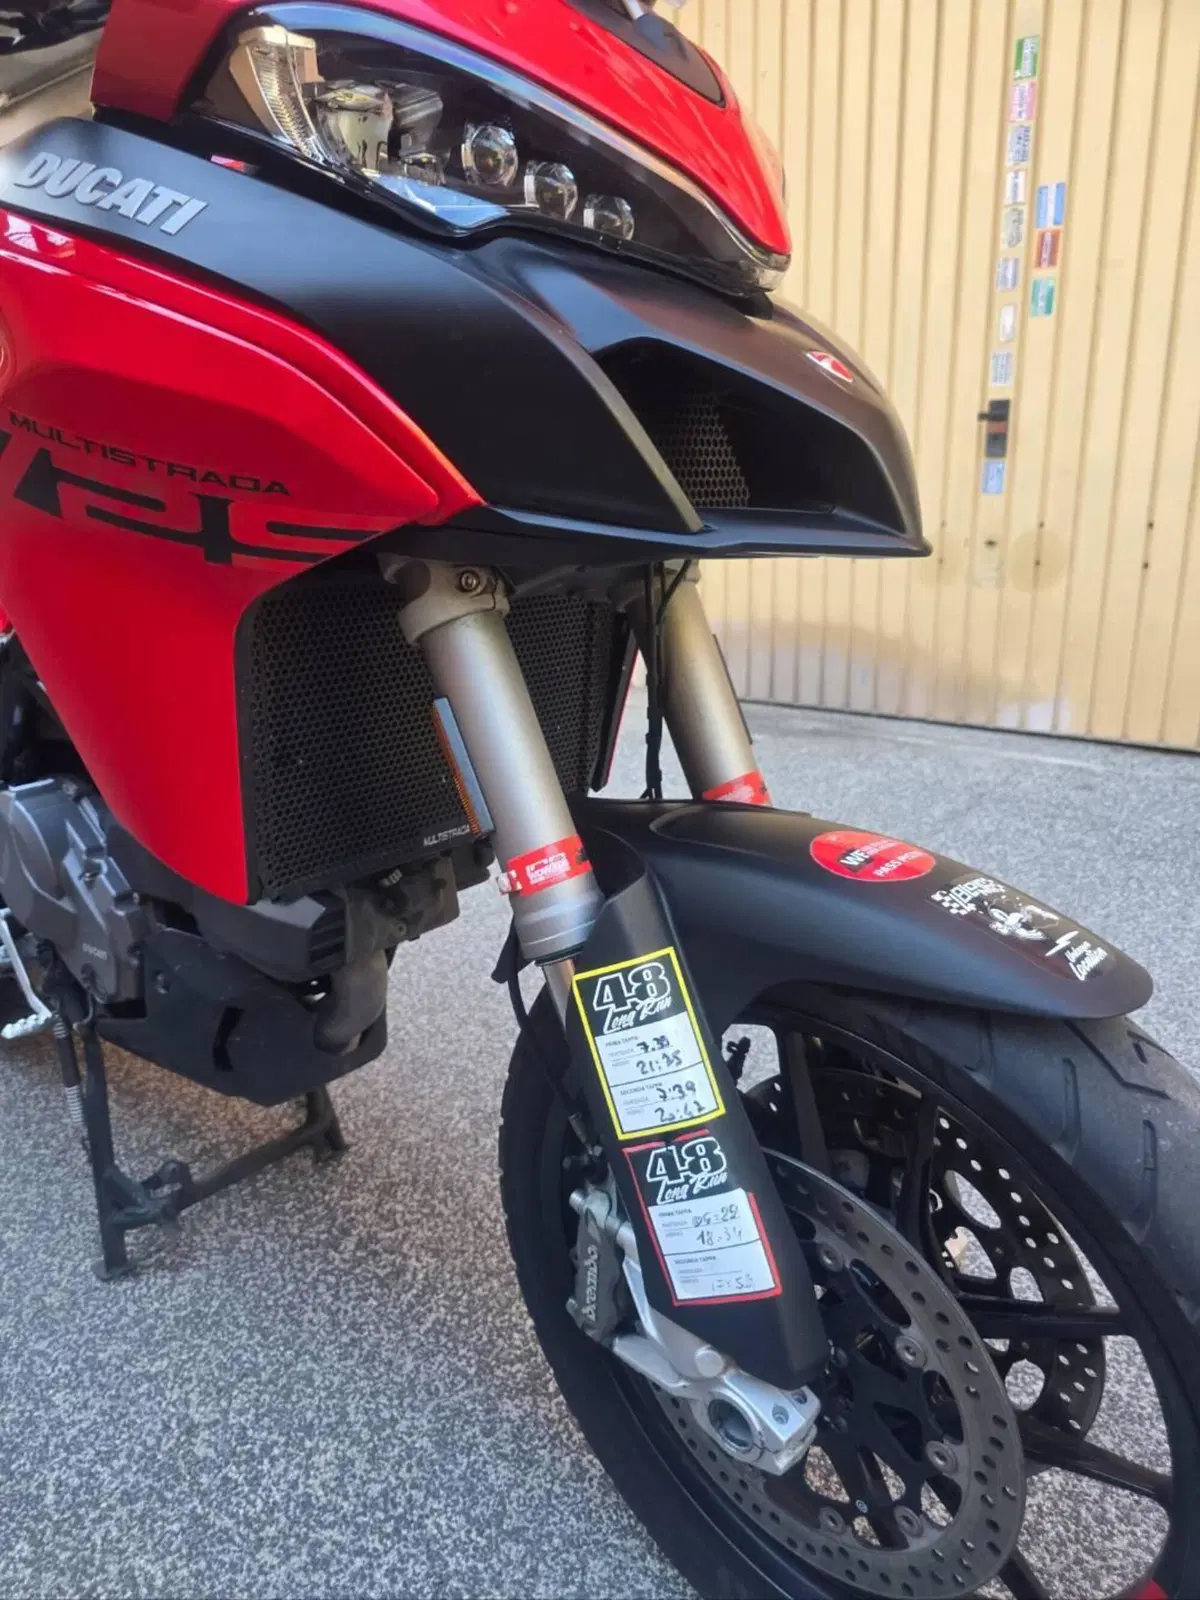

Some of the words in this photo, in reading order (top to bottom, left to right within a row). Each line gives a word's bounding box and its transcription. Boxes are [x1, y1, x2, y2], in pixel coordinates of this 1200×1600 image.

[13, 151, 208, 236] DUCATI
[8, 411, 291, 496] MULTISTRADA
[593, 961, 672, 1013] 48
[602, 1006, 638, 1035] Long
[646, 1136, 727, 1185] 48
[656, 1179, 689, 1205] Long
